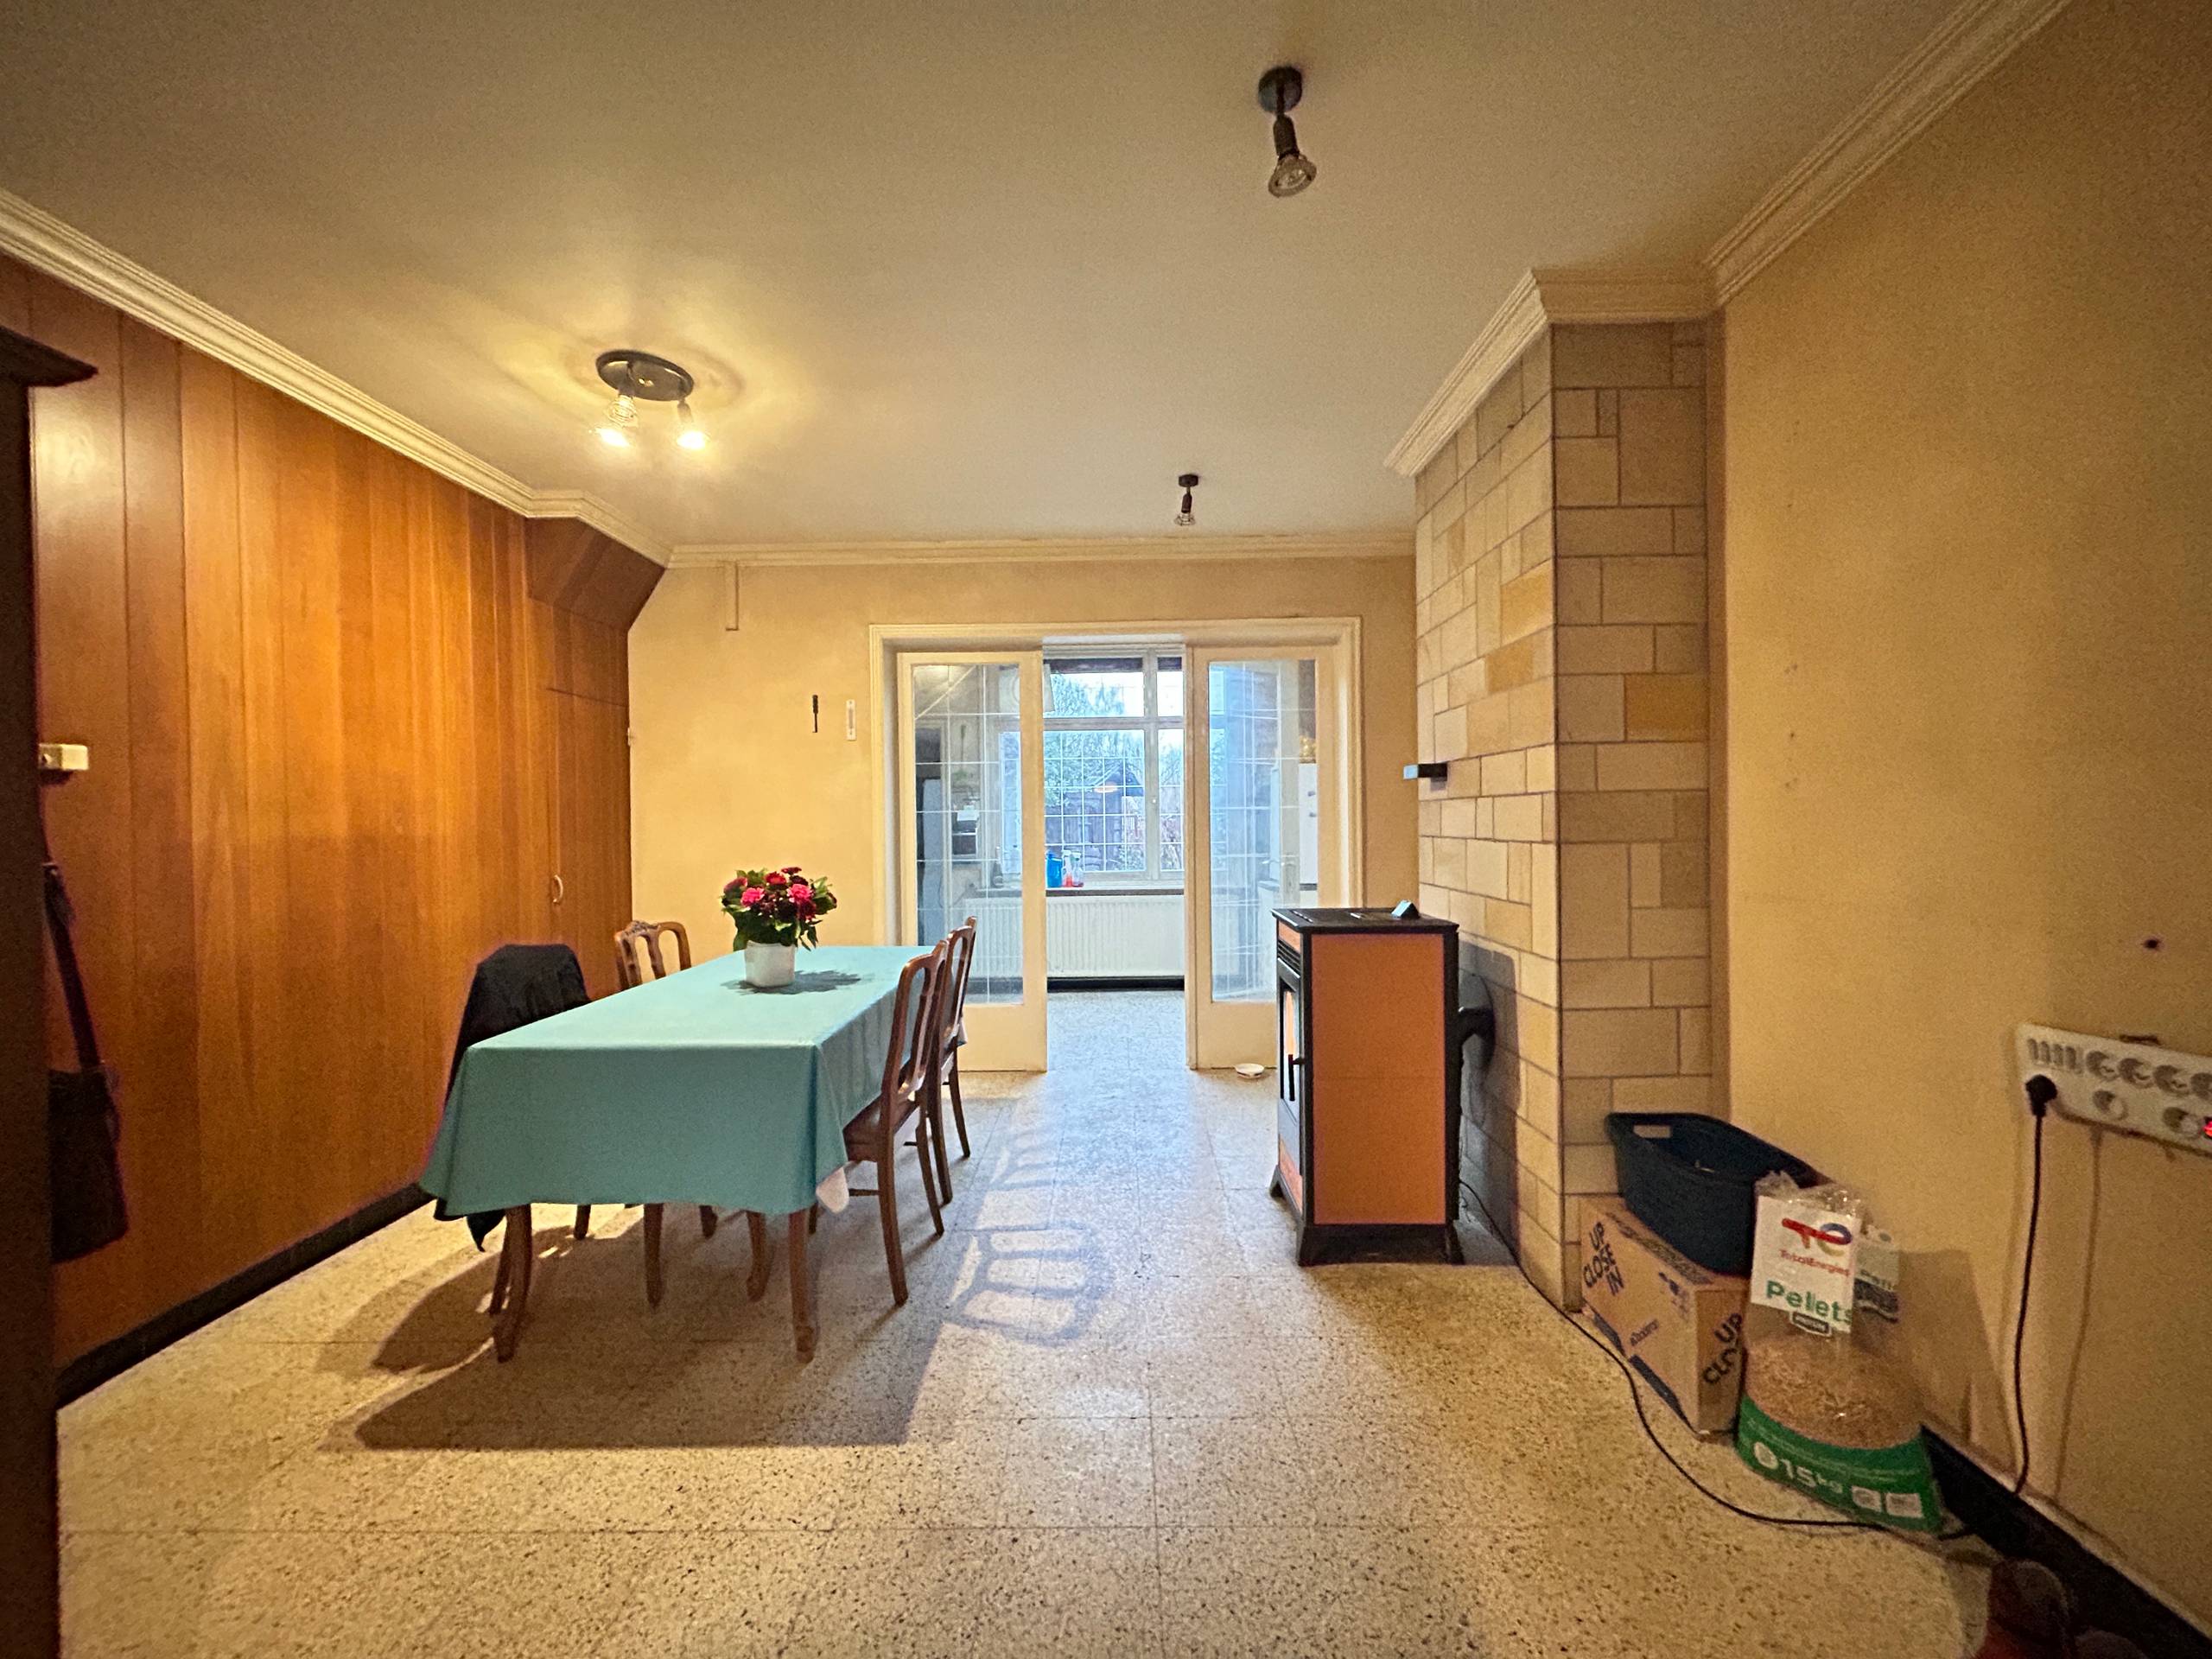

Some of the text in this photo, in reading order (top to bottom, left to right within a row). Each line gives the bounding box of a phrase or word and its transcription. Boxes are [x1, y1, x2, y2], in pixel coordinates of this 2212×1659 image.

[1589, 1222, 1605, 1251] UP
[1583, 1243, 1617, 1288] CLOSE
[1606, 1265, 1624, 1296] IN
[1713, 1313, 1742, 1343] UP
